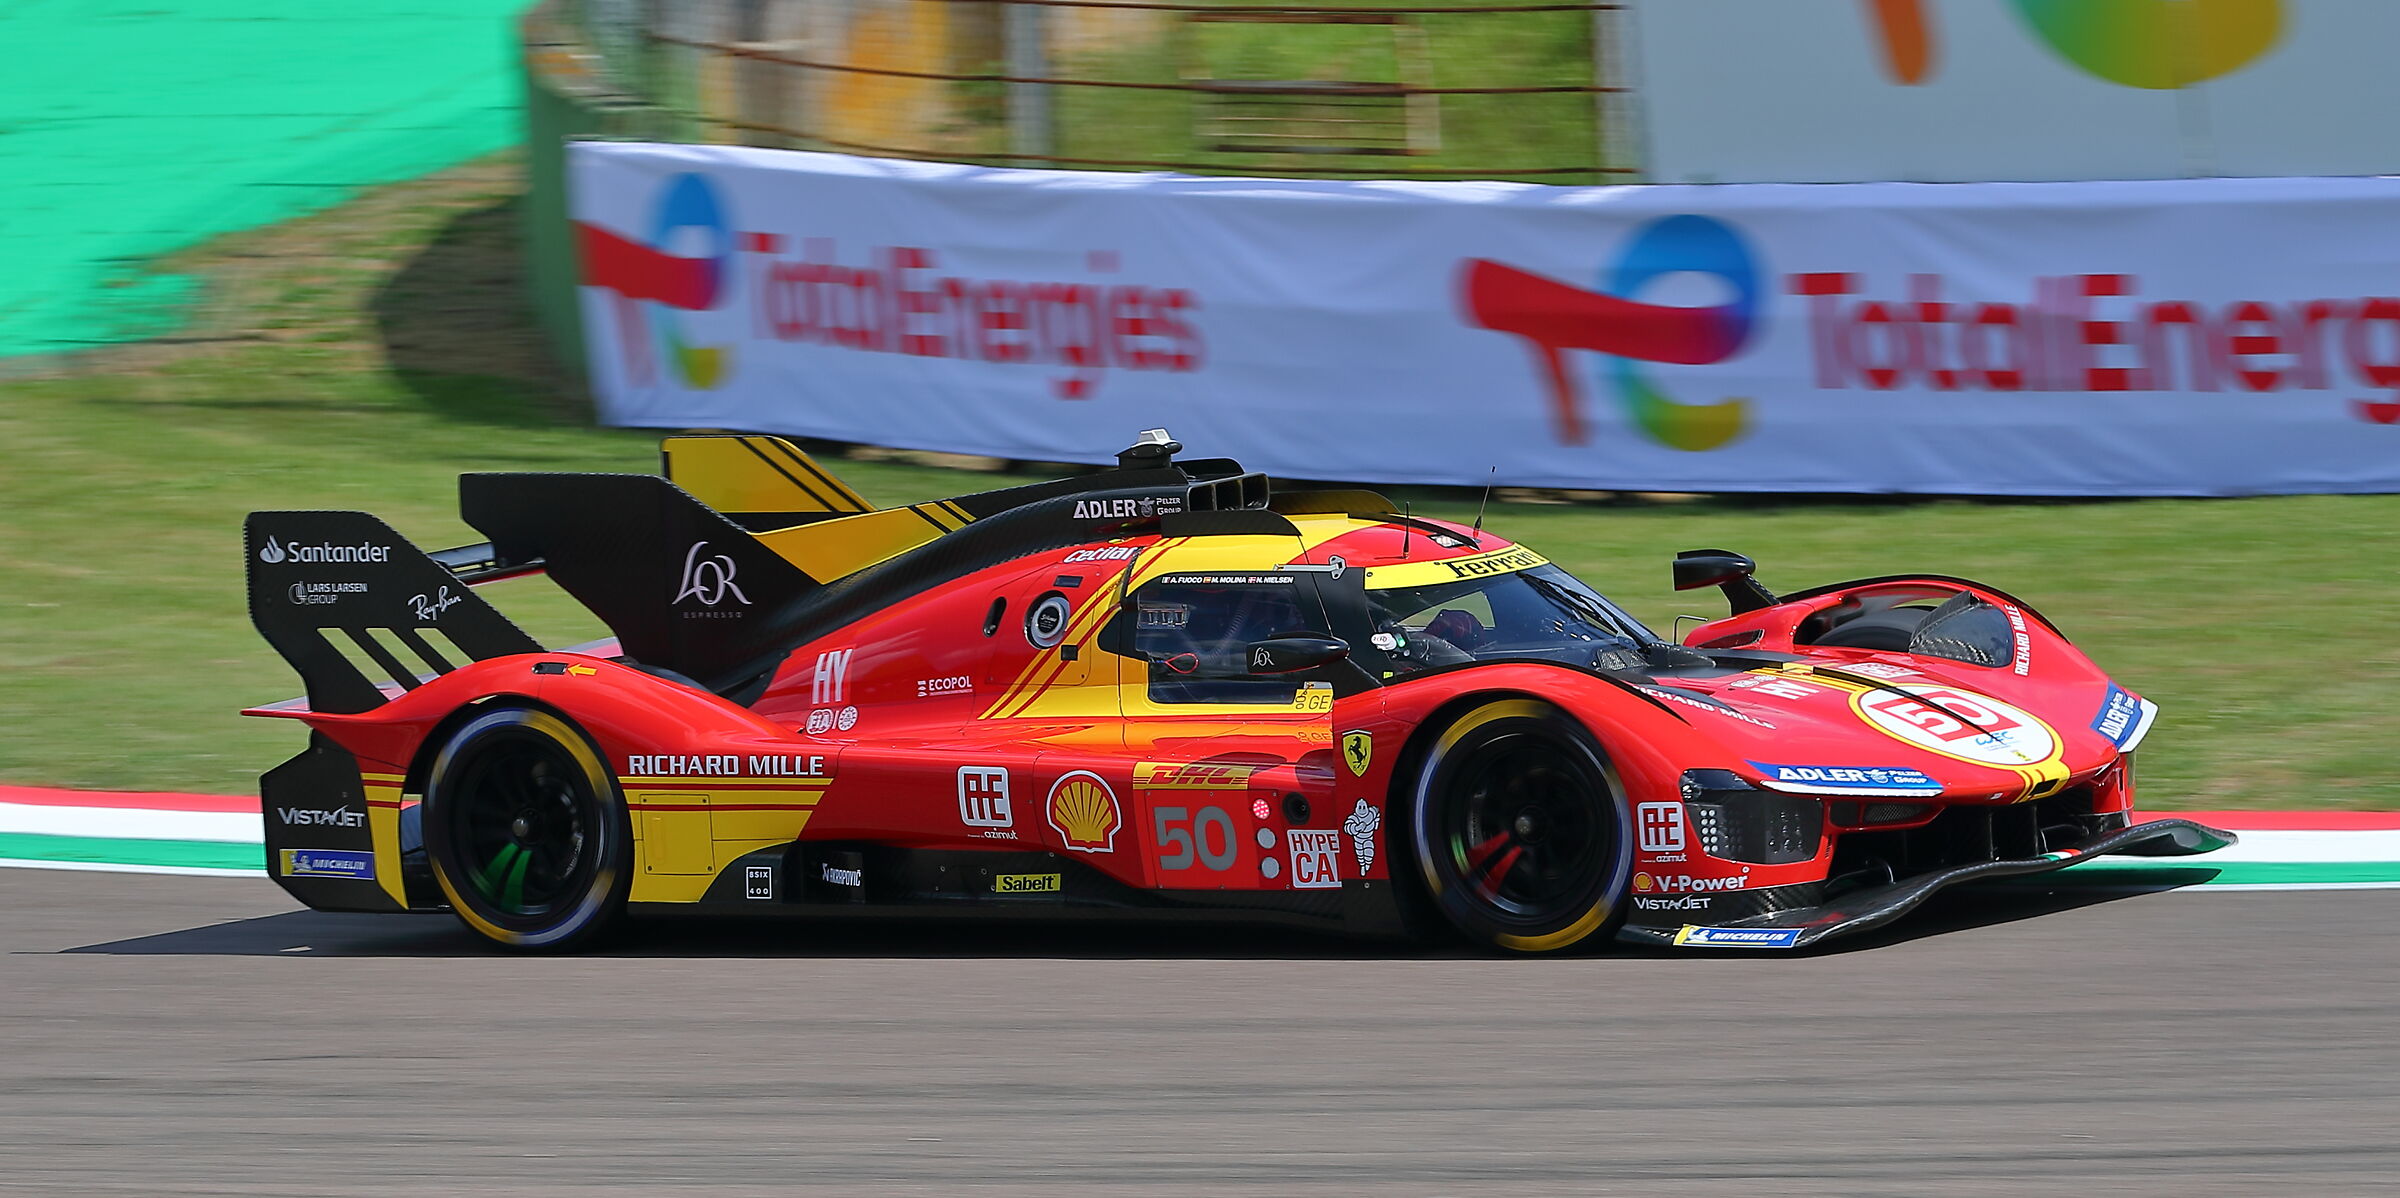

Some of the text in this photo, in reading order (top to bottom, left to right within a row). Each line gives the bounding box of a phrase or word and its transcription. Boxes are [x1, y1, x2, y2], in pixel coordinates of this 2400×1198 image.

[738, 232, 1205, 400] TotalEnergies
[1073, 500, 1137, 519] ADLER
[1156, 498, 1181, 506] PELZER
[1157, 507, 1182, 515] GROUP
[288, 541, 391, 563] Santander
[1441, 545, 1545, 578] Ferrari
[307, 583, 368, 592] LARS LARSEN
[307, 595, 338, 604] GROUP
[408, 586, 462, 621] Ray-Ban
[2004, 604, 2030, 676] RICHARD MILLE
[812, 649, 853, 704] HY
[928, 675, 972, 691] ECOPOL
[1751, 680, 1819, 700] HY
[1884, 696, 1999, 735] 50
[628, 755, 824, 775] RICHARD MILLE
[1148, 766, 1234, 784] DHL
[1778, 767, 1869, 782] ADLER
[984, 827, 1018, 840] azimut
[1154, 806, 1238, 872] 50
[312, 859, 367, 870] MICHELIN
[1655, 851, 1688, 863] azimut
[1296, 853, 1340, 883] CA
[1002, 875, 1055, 891] Sabelt
[1655, 875, 1748, 892] V-Power
[1711, 933, 1790, 941] MICHELIN
